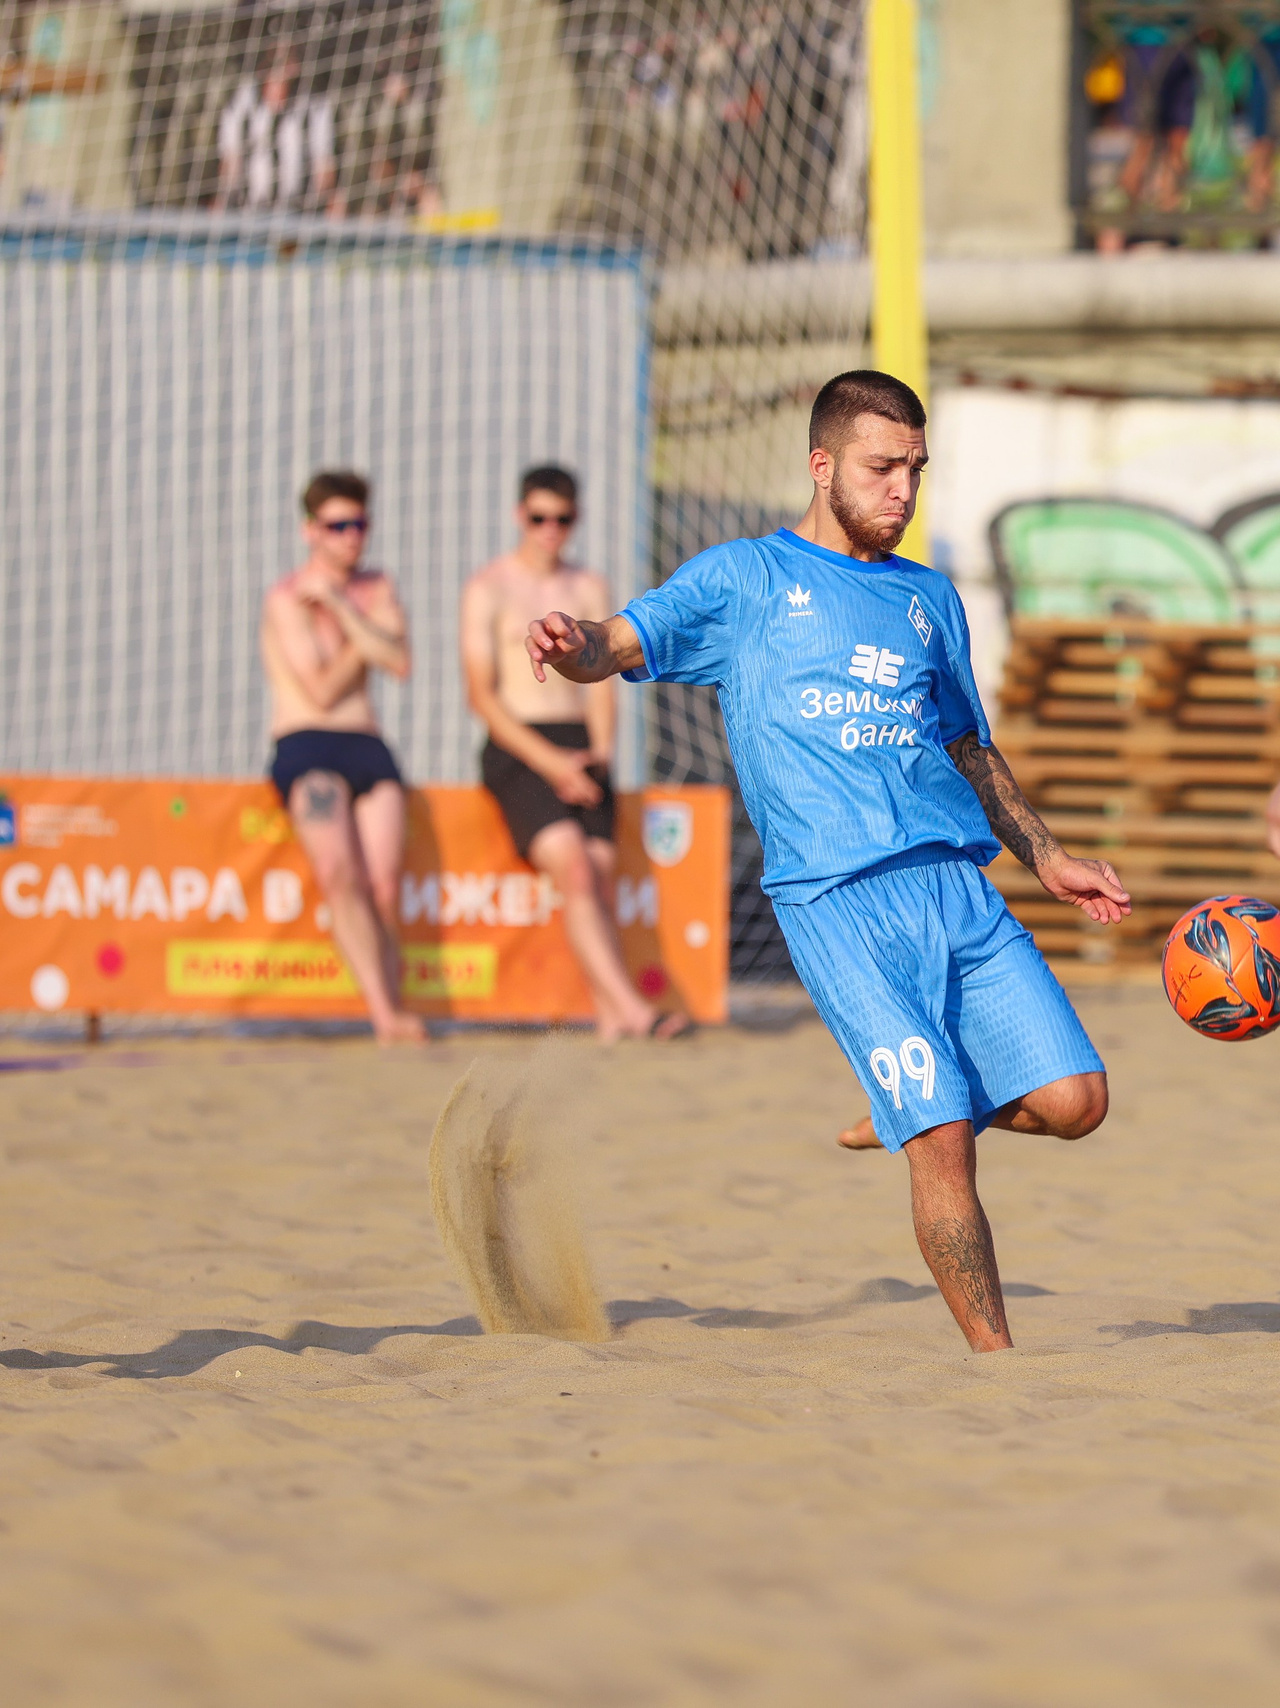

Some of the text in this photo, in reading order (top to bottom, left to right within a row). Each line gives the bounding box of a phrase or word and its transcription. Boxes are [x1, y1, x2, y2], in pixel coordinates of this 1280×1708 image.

[788, 610, 814, 618] PRIMERA
[800, 687, 925, 723] Земский
[840, 717, 918, 751] банк
[1, 861, 249, 924] САМАРА
[870, 1036, 935, 1110] 99
